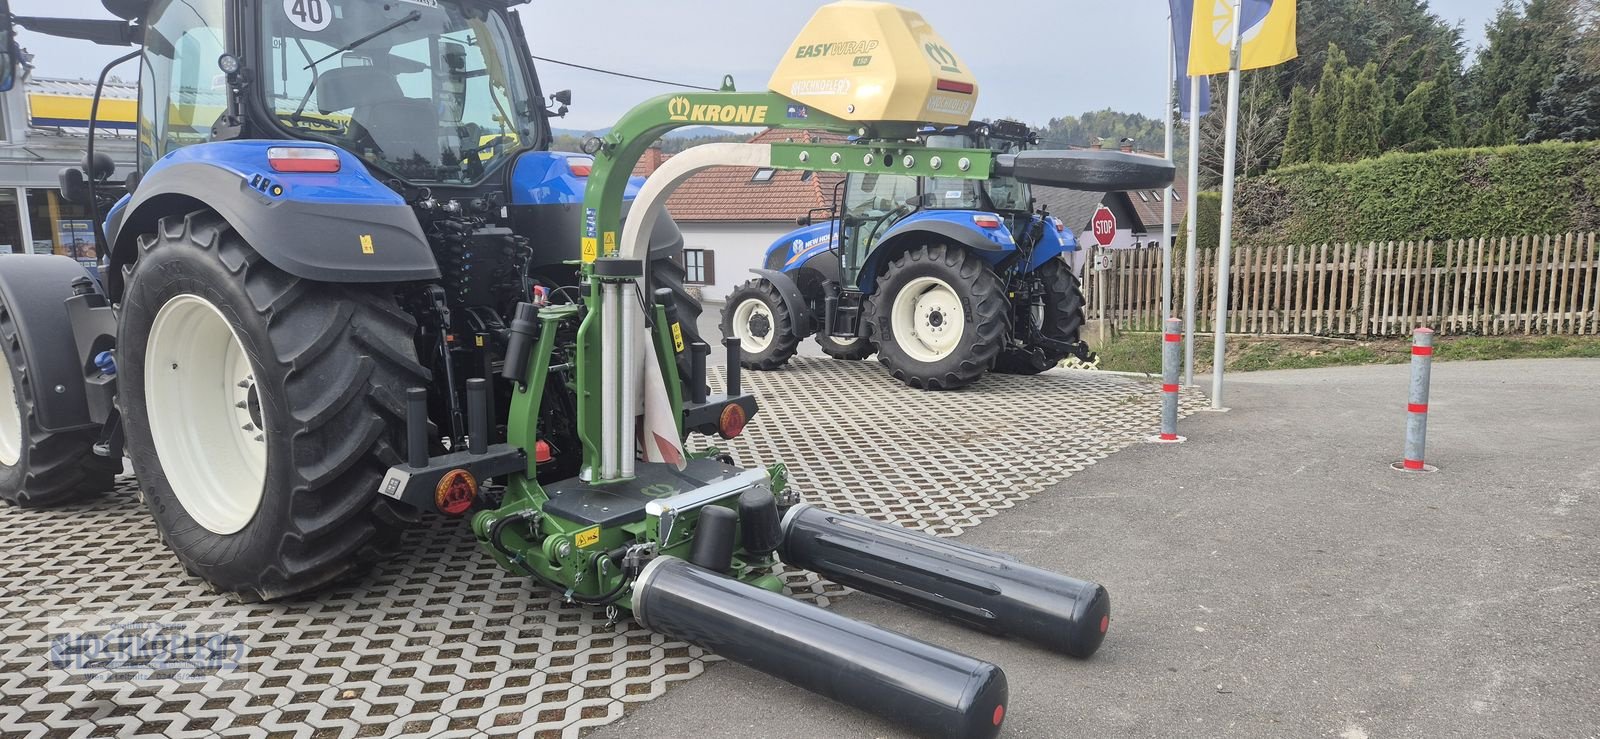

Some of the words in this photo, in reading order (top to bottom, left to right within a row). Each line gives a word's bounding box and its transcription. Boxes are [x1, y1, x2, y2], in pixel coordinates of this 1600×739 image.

[291, 0, 325, 25] 40
[795, 39, 880, 59] EASYWRAP
[690, 104, 769, 123] KRONE
[1095, 219, 1113, 235] STOP
